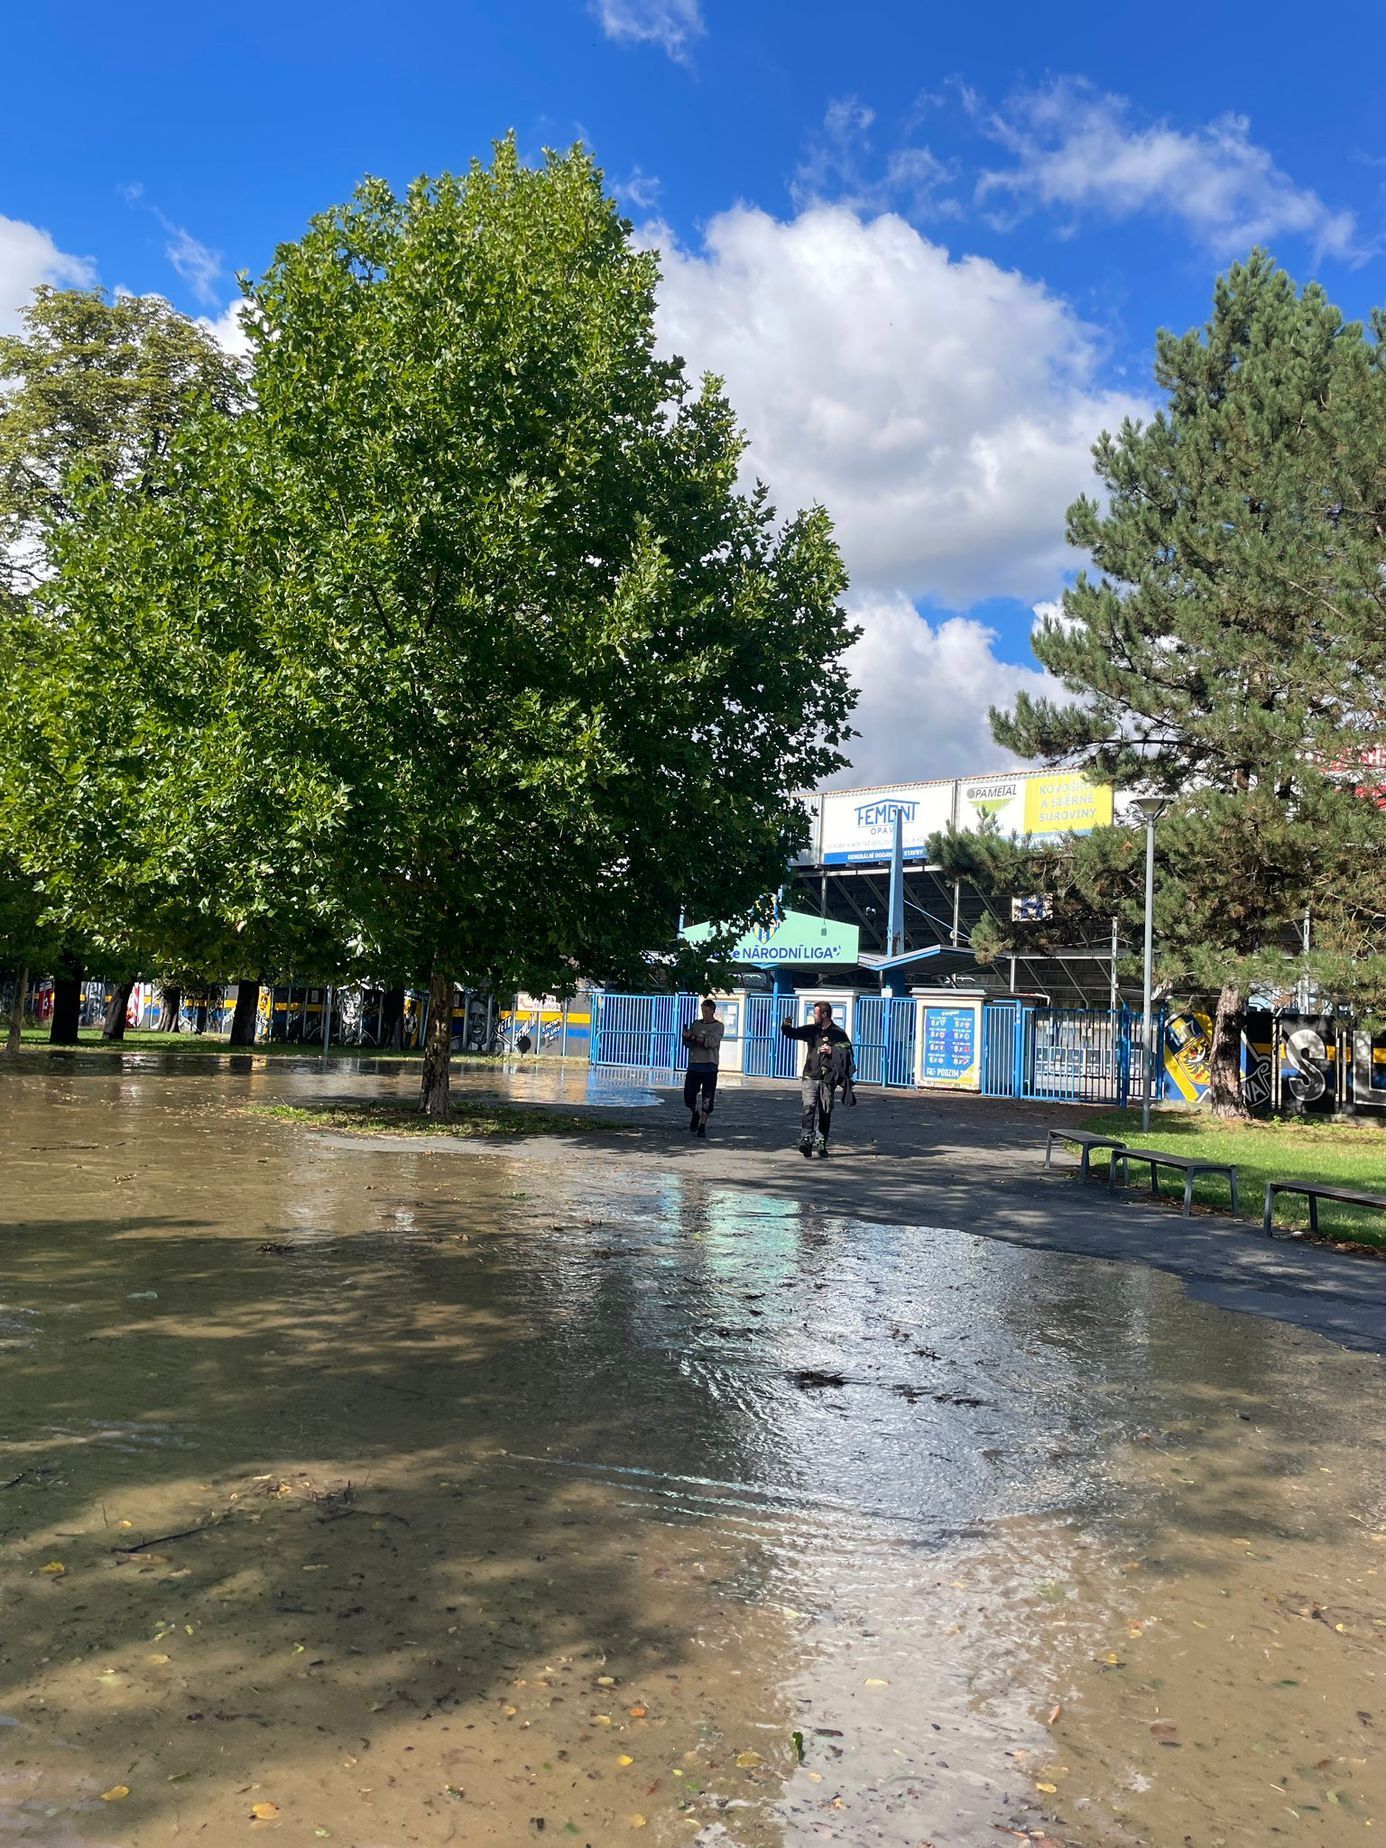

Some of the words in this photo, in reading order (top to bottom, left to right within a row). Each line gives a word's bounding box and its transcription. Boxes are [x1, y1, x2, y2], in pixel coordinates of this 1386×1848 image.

[1041, 798, 1048, 809] A
[855, 799, 920, 825] FEMONT
[1039, 808, 1097, 822] SUROVINY
[870, 826, 895, 836] OPAV
[804, 947, 834, 959] LIGA
